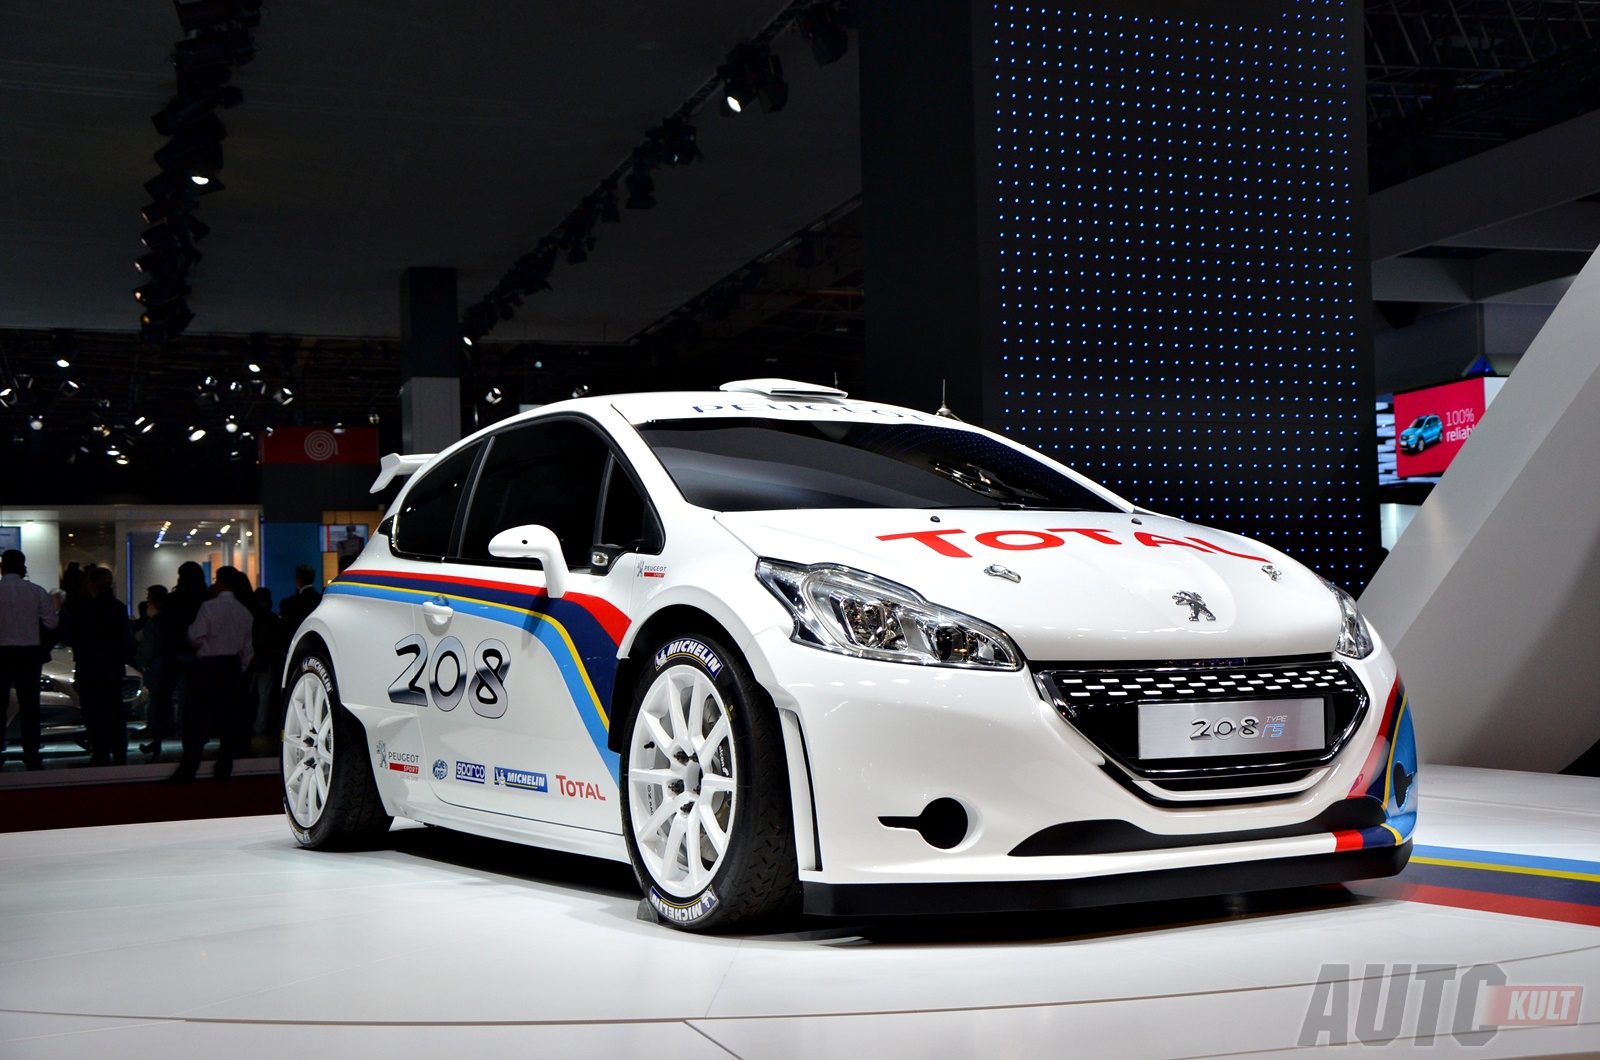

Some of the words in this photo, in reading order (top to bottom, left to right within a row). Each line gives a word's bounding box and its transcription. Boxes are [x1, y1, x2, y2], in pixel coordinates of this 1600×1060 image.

[692, 403, 926, 422] PEUGEOT
[1446, 407, 1475, 427] 100%
[875, 528, 1273, 563] TOTAL
[667, 640, 721, 673] MICHELIN
[308, 658, 332, 693] MICHELIN
[388, 634, 511, 719] 208
[1190, 716, 1260, 740] 208
[1266, 715, 1288, 723] TYPE
[388, 751, 419, 763] PEUGEOT
[403, 765, 419, 773] SPORT
[457, 762, 485, 779] sparco
[507, 772, 545, 787] MICHELIN
[555, 775, 606, 801] TOTAL
[651, 894, 703, 921] MICHELIN
